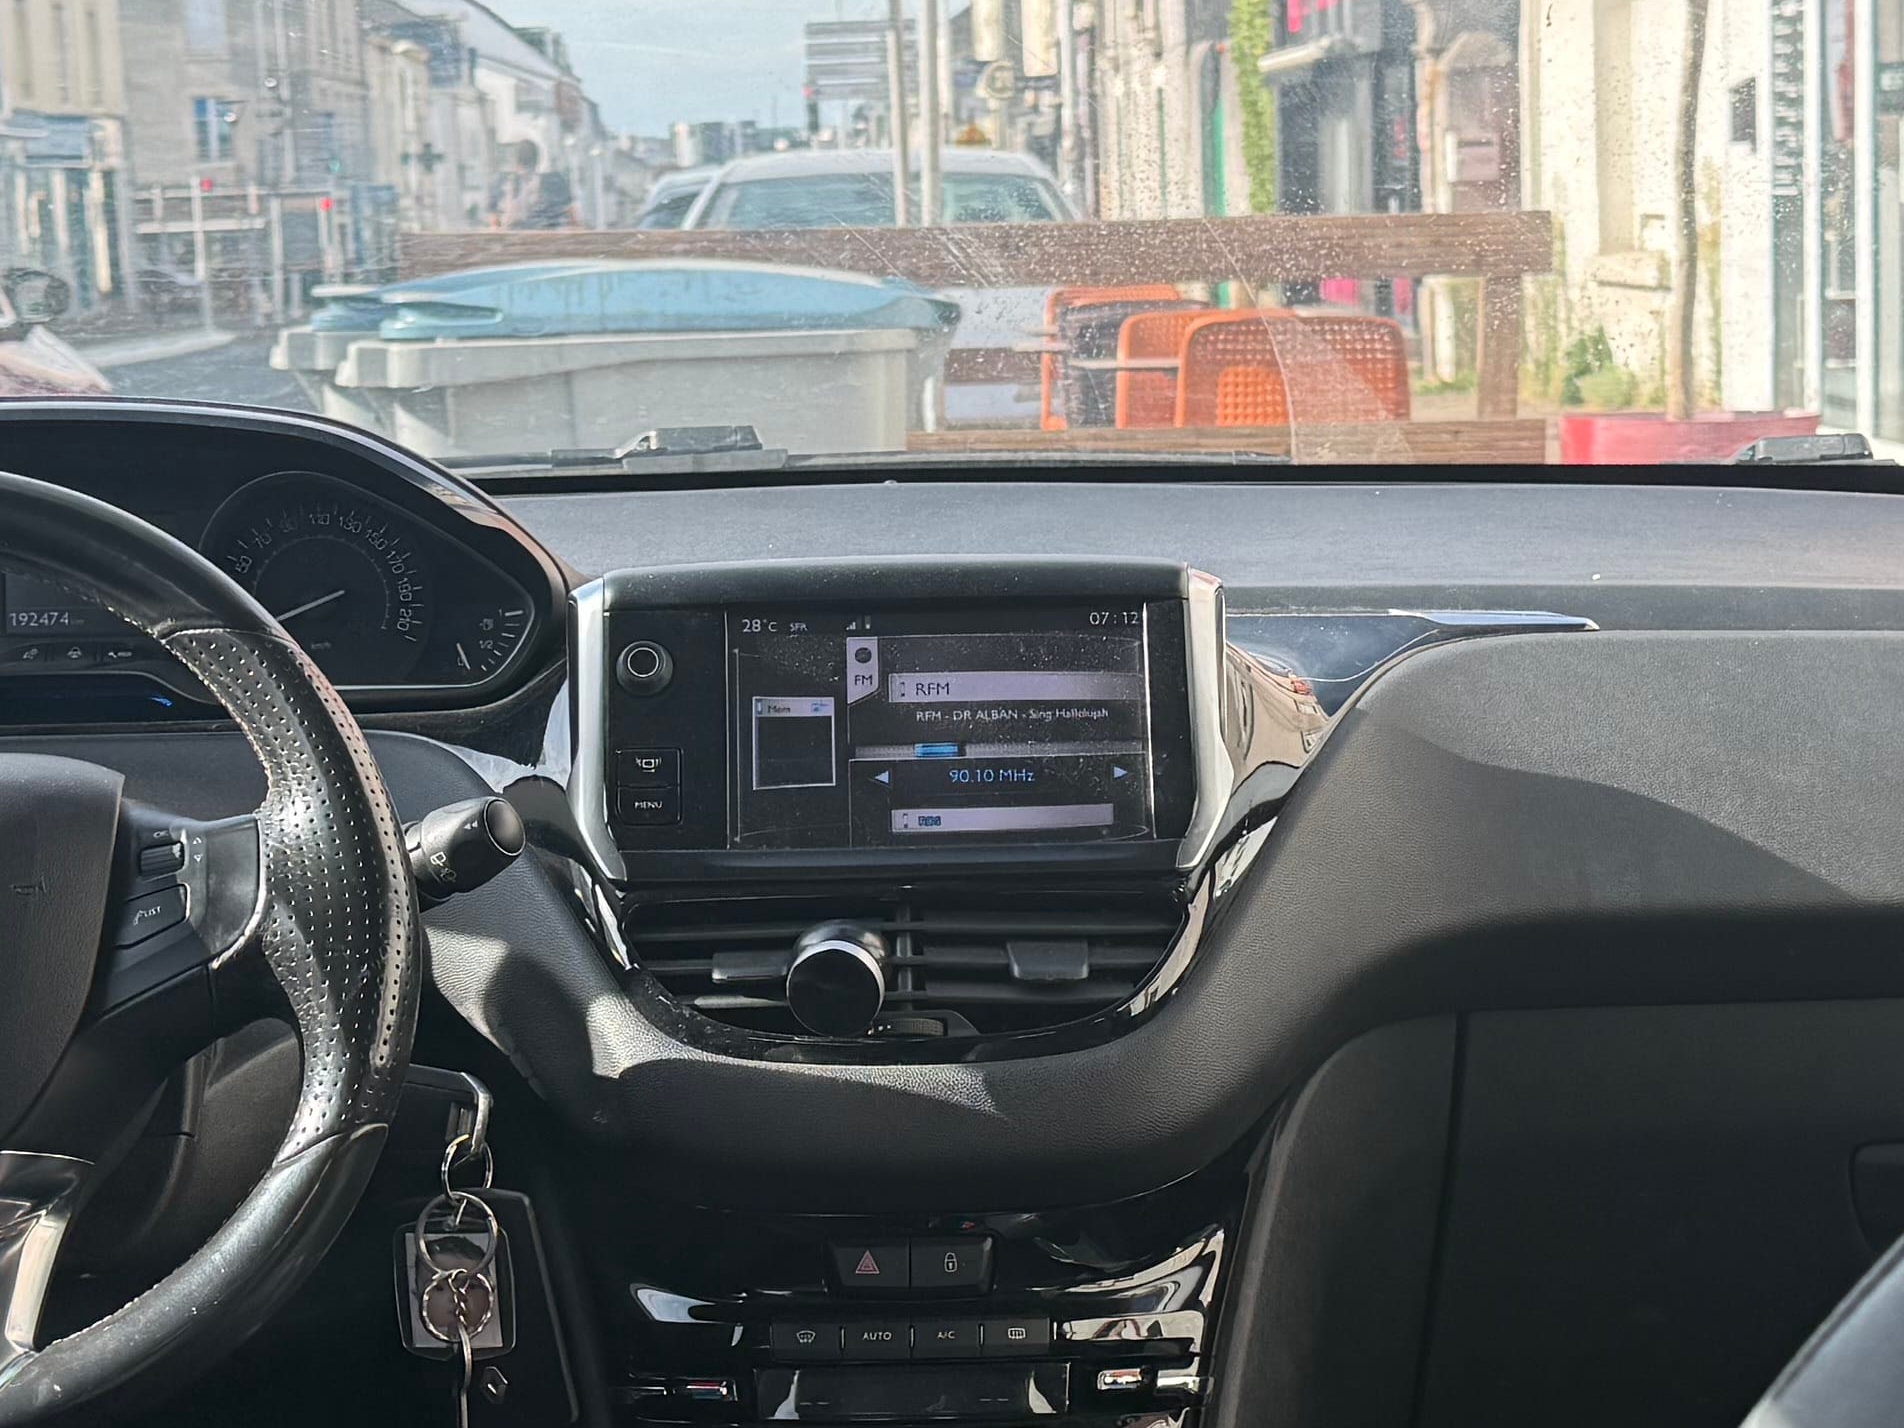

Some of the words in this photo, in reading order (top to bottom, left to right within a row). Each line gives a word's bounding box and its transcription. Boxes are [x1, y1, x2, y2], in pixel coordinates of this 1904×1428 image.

[9, 611, 70, 627] 192474
[854, 674, 873, 686] FM
[915, 682, 950, 696] RFM
[916, 710, 942, 722] RFM
[953, 709, 972, 721] DR
[976, 708, 1018, 722] ALBAN
[949, 768, 995, 783] 90.10
[999, 768, 1036, 783] MHz
[634, 800, 663, 810] MENU
[862, 1331, 893, 1341] AUTO
